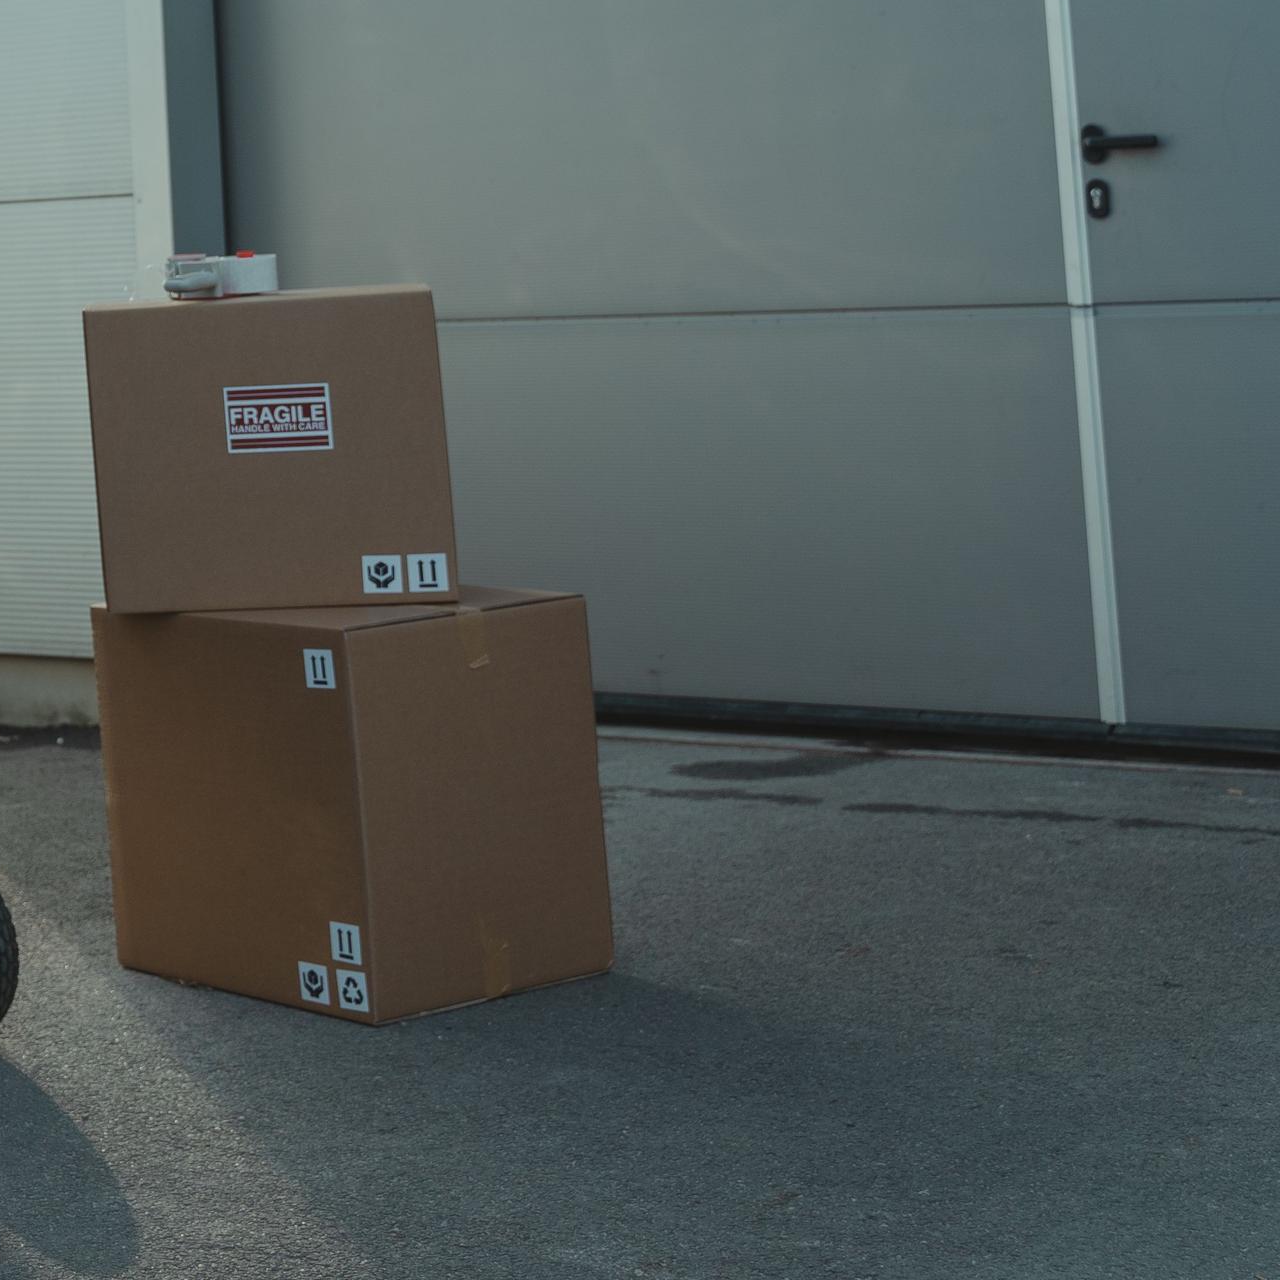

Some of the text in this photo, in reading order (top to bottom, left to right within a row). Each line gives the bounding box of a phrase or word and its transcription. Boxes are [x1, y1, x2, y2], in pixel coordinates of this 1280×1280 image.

[229, 404, 325, 424] FRAGILE
[231, 422, 325, 433] HANDLE WITH CARE
